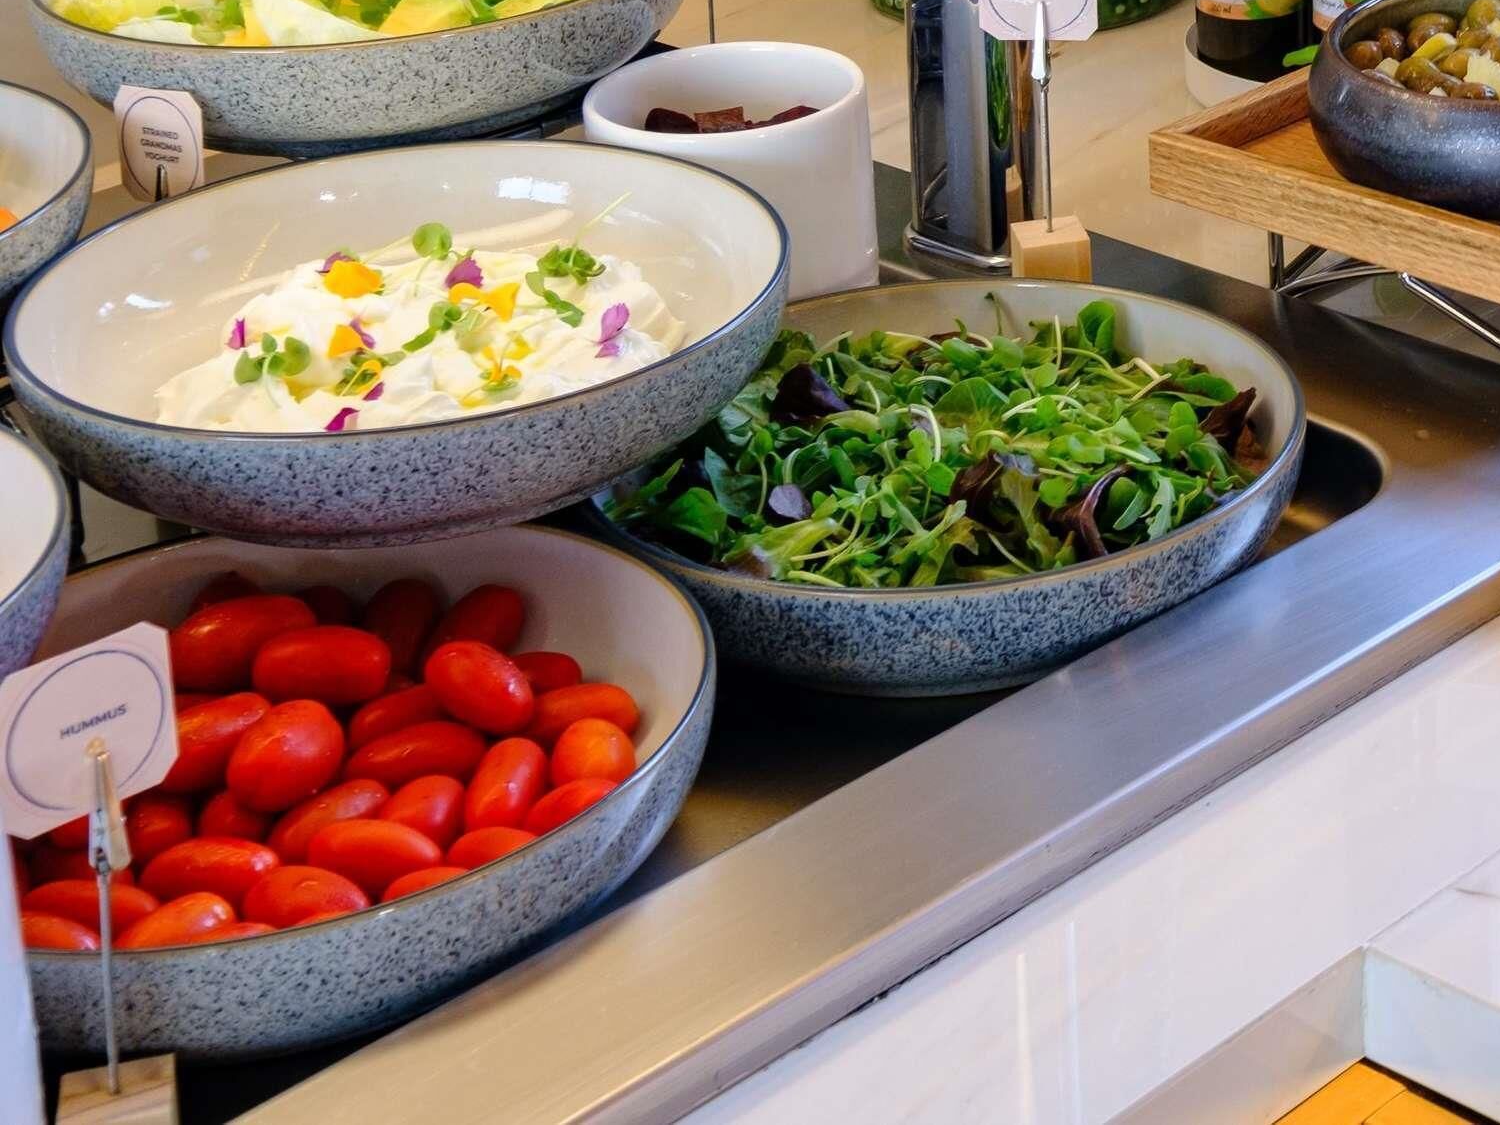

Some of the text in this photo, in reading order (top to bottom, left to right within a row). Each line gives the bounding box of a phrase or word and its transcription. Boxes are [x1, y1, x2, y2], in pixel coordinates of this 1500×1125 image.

[142, 126, 179, 140] STRAINED
[139, 138, 183, 153] GRANDMAS
[58, 703, 129, 740] HUMMUS
